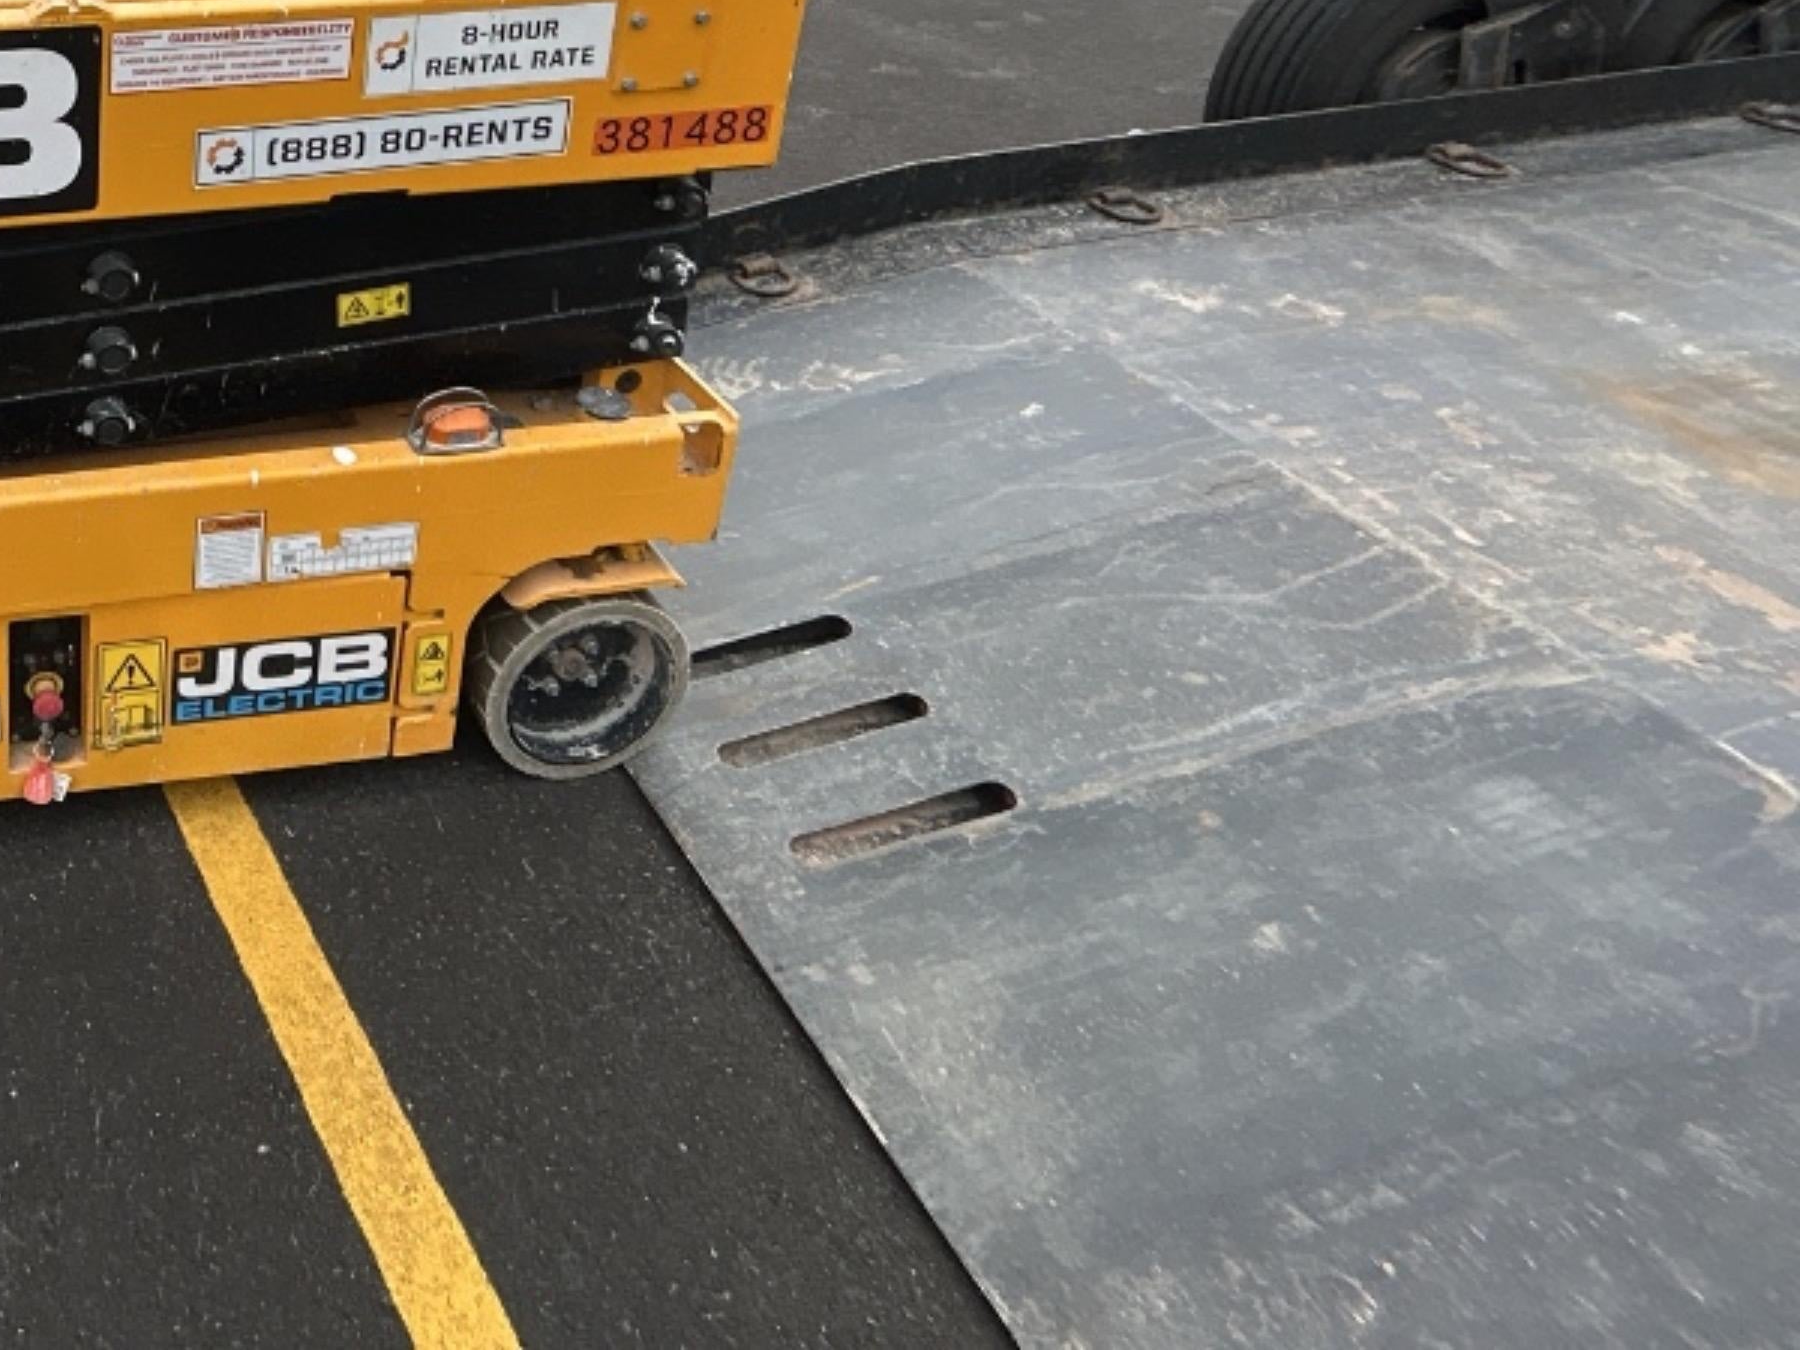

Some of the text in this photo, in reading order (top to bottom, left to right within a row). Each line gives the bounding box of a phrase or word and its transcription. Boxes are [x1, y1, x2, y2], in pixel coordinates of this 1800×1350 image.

[461, 19, 559, 45] 8-HOUR
[425, 46, 595, 79] RENTAL RATE
[266, 116, 553, 166] (888) 80-RENTS
[598, 106, 767, 155] 381488
[177, 633, 388, 697] JCB
[176, 680, 385, 722] ELECTRIC
